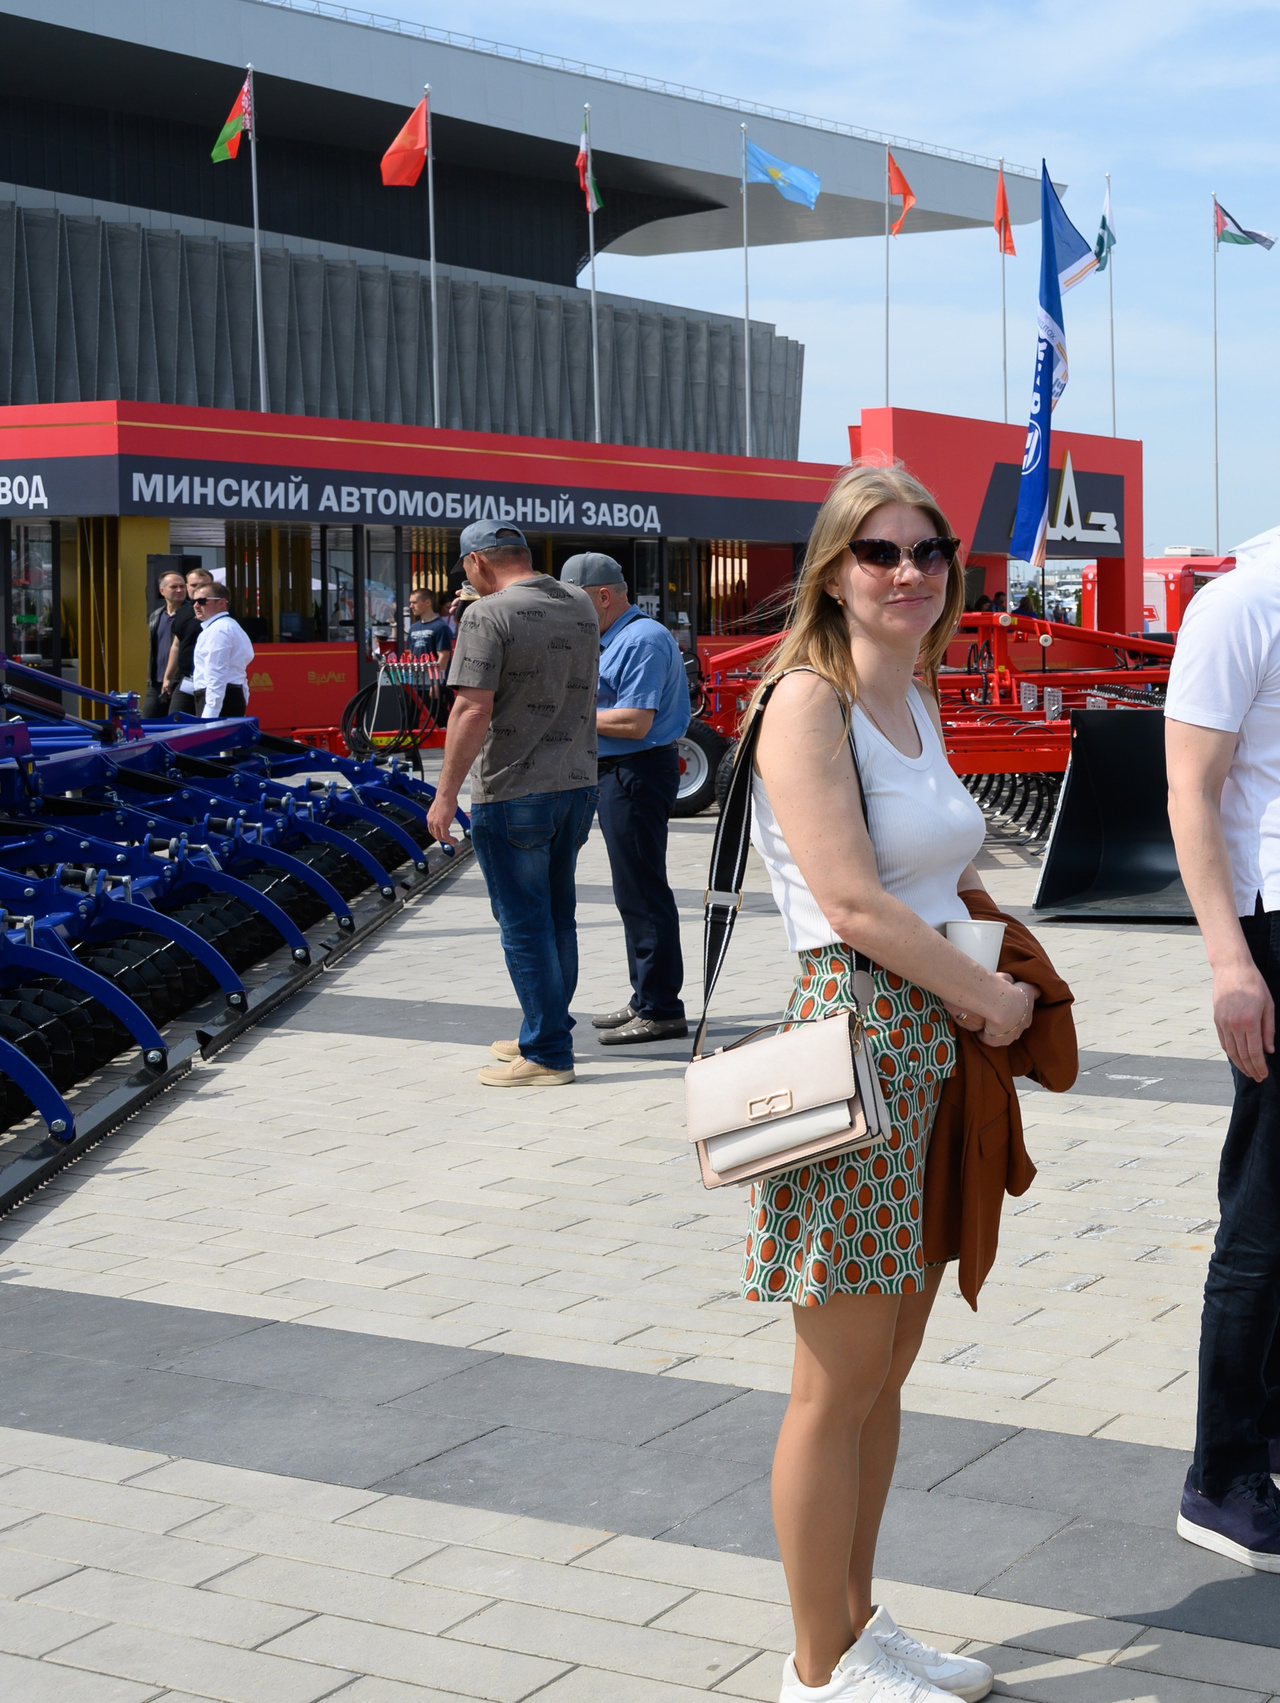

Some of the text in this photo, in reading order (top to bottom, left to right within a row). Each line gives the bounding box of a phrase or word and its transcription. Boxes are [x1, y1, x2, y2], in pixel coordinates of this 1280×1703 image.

[0, 475, 48, 510] ВОД
[132, 472, 661, 533] МИНСКИЙ АВТОМОБИЛЬНЫЙ ЗАВОД
